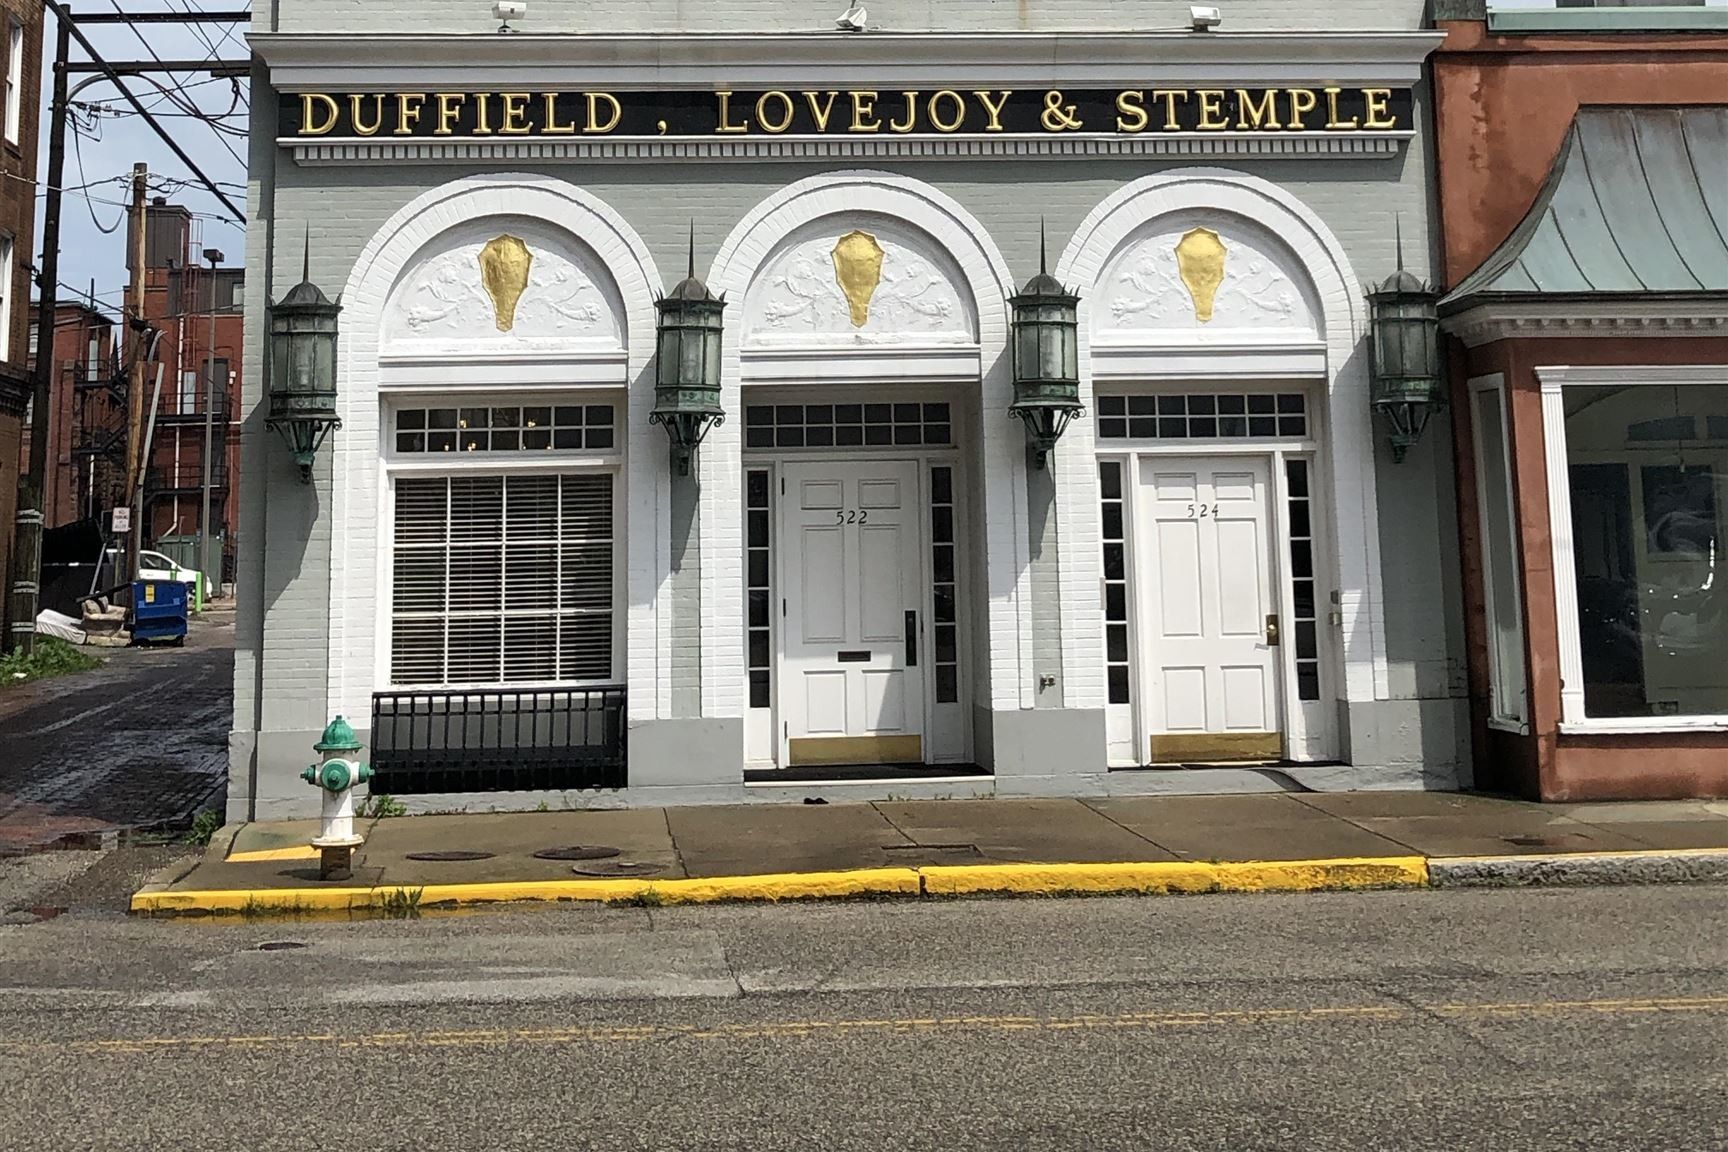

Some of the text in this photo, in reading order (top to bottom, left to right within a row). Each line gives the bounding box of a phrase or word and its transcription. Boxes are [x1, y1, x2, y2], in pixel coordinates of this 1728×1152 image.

[715, 90, 1012, 133] LOVEJOY
[1040, 91, 1083, 131] &
[1116, 87, 1398, 131] STEMPLE
[836, 510, 868, 525] 522
[1187, 503, 1219, 518] 524
